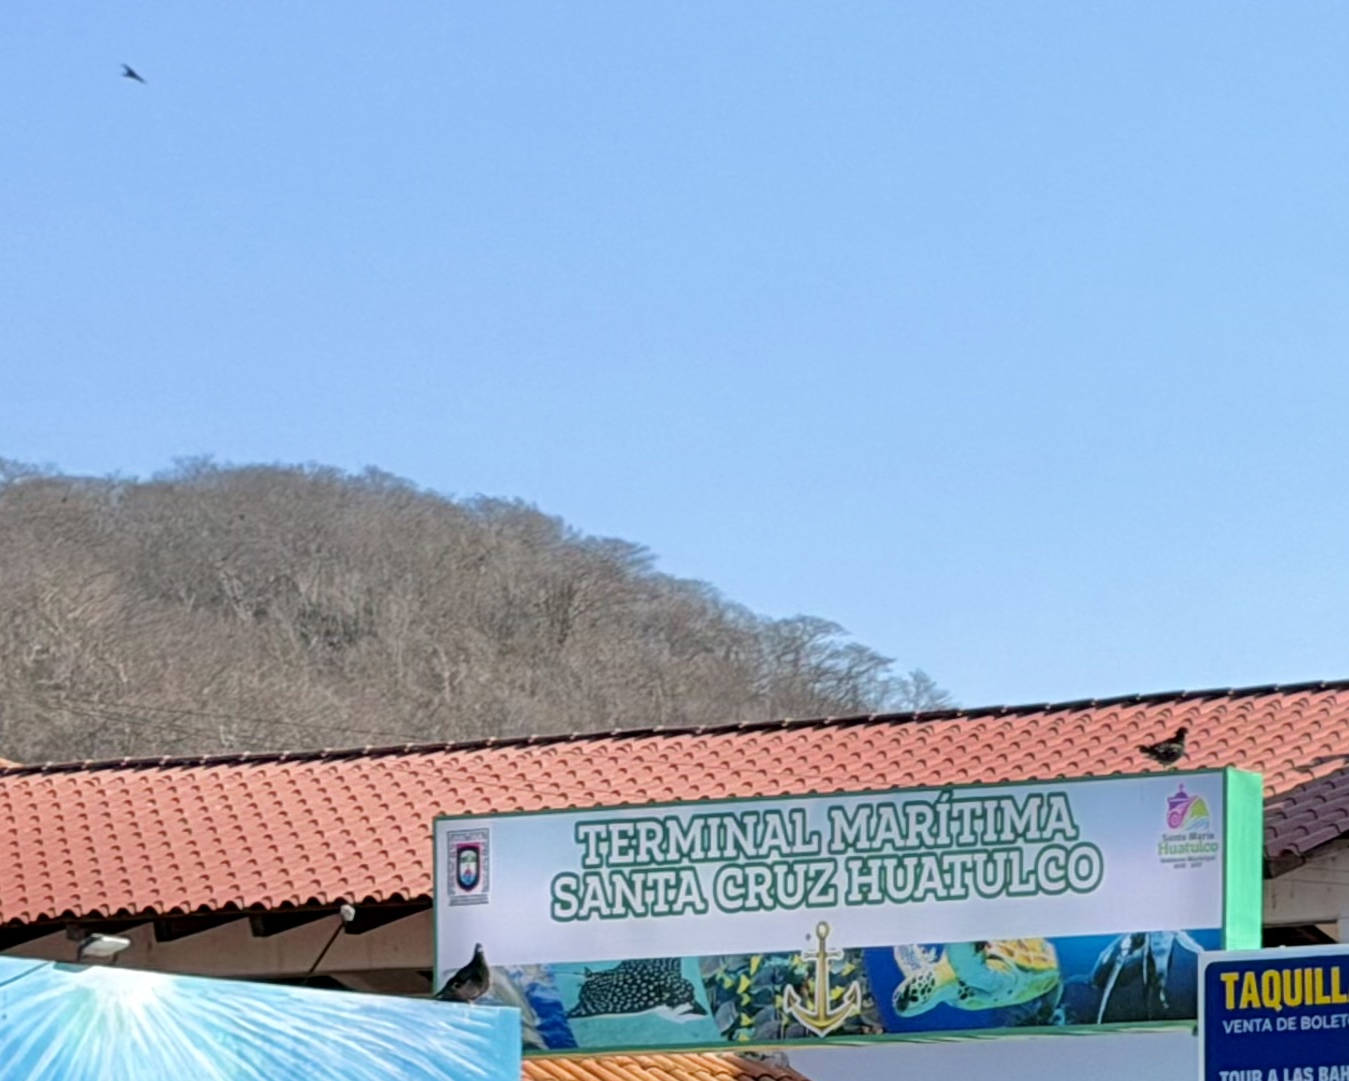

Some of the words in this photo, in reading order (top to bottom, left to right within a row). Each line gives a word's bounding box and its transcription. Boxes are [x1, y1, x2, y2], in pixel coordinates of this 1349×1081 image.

[577, 809, 819, 868] TERMINAL
[829, 792, 1079, 854] MARÍTIMA
[1157, 842, 1219, 856] Huatulco
[553, 868, 708, 921] SANTA
[713, 857, 836, 911] CRUZ
[846, 843, 1103, 907] HUATULCO
[1222, 1018, 1273, 1034] VENTA
[1276, 1016, 1297, 1032] DE
